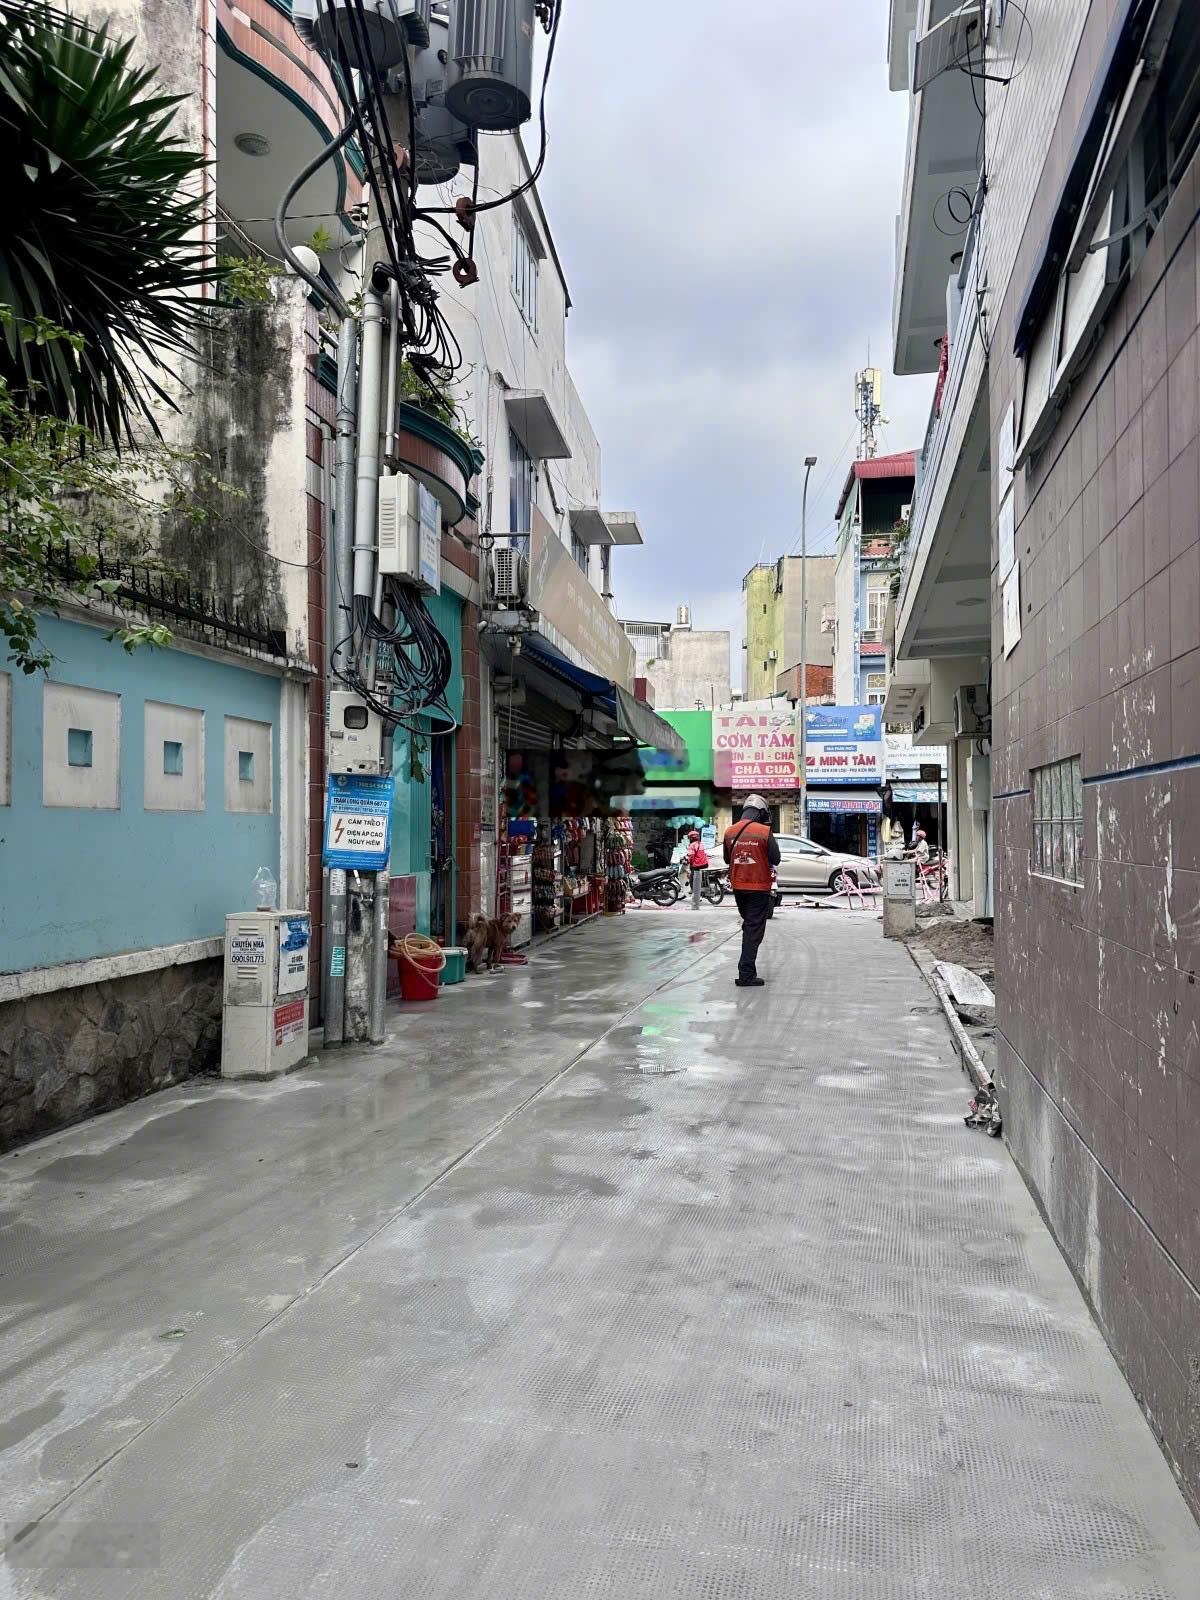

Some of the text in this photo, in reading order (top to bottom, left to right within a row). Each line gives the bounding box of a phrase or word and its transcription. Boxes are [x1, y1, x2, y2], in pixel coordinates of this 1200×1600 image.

[716, 727, 795, 748] CƠM TẤM
[819, 754, 876, 766] MINH TÂM
[765, 765, 792, 774] CUA
